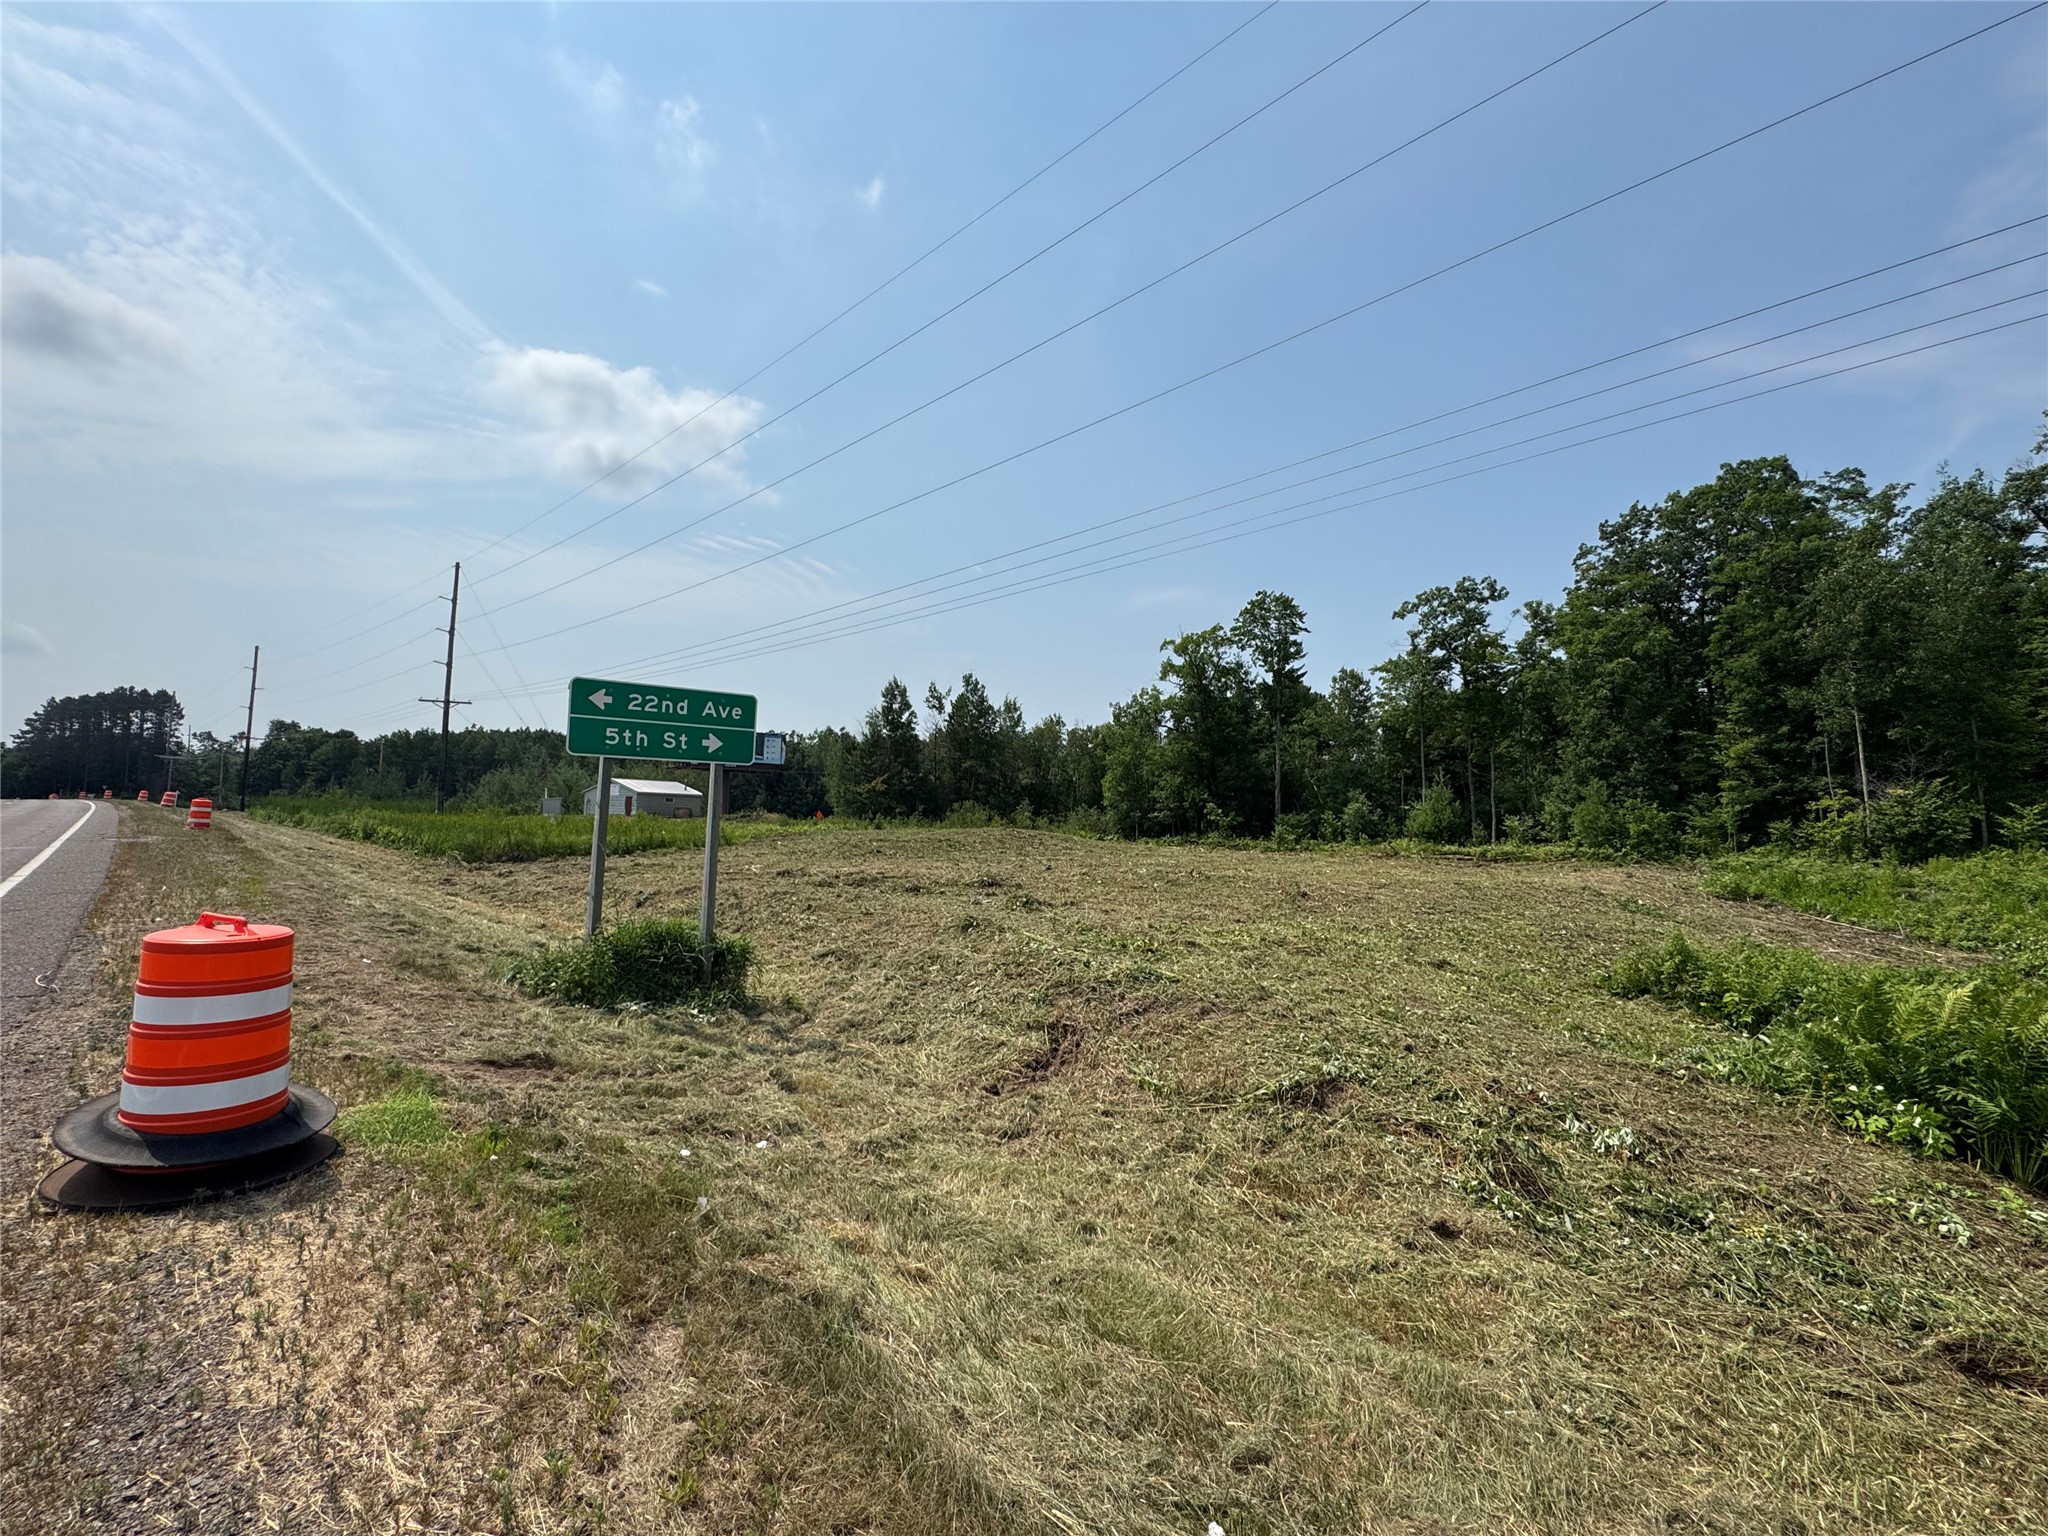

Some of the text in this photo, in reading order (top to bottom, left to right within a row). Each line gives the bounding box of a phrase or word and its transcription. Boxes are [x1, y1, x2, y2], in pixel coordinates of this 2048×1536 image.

[627, 693, 743, 719] 22nd Ave
[605, 727, 688, 750] 5th St
